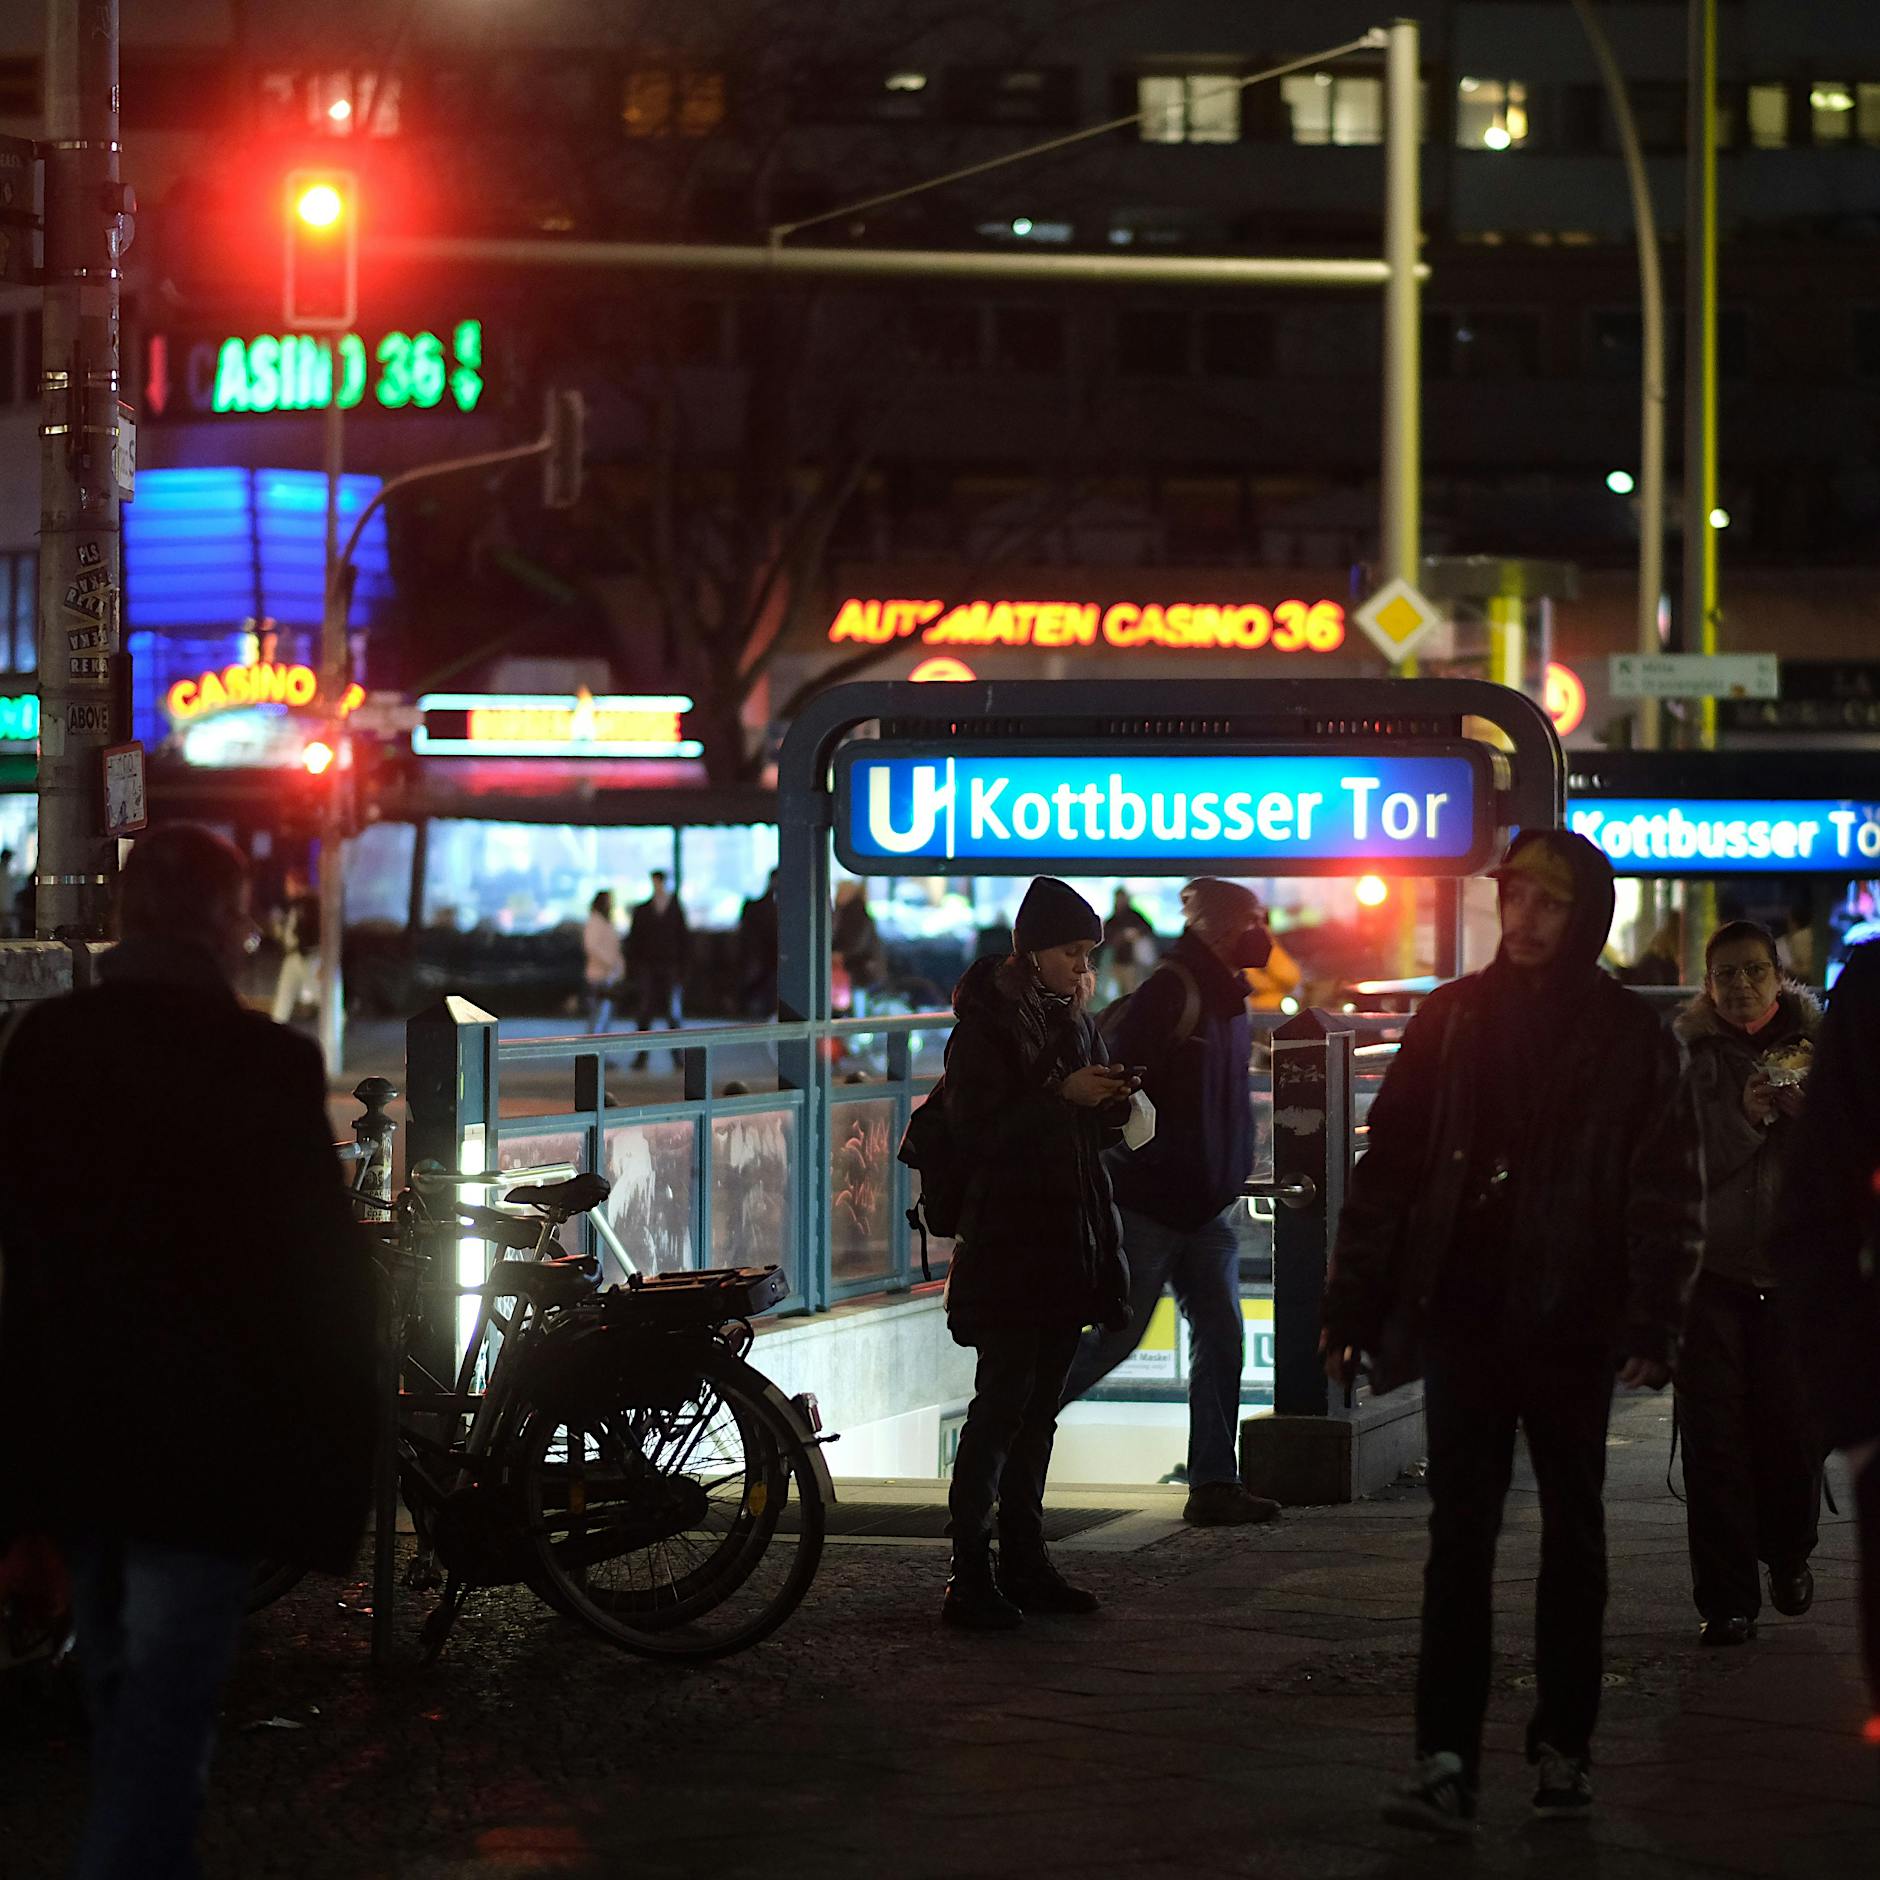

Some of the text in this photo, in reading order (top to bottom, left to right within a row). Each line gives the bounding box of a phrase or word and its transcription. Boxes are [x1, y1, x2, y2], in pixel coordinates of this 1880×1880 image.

[376, 331, 446, 409] 36
[1102, 602, 1273, 649] CASINO
[1271, 598, 1346, 652] 36
[69, 707, 107, 729] ABOVE
[167, 662, 317, 720] CASINO
[869, 766, 1447, 852] U Kottbusser Tor
[1572, 808, 1820, 859] Kottbusser
